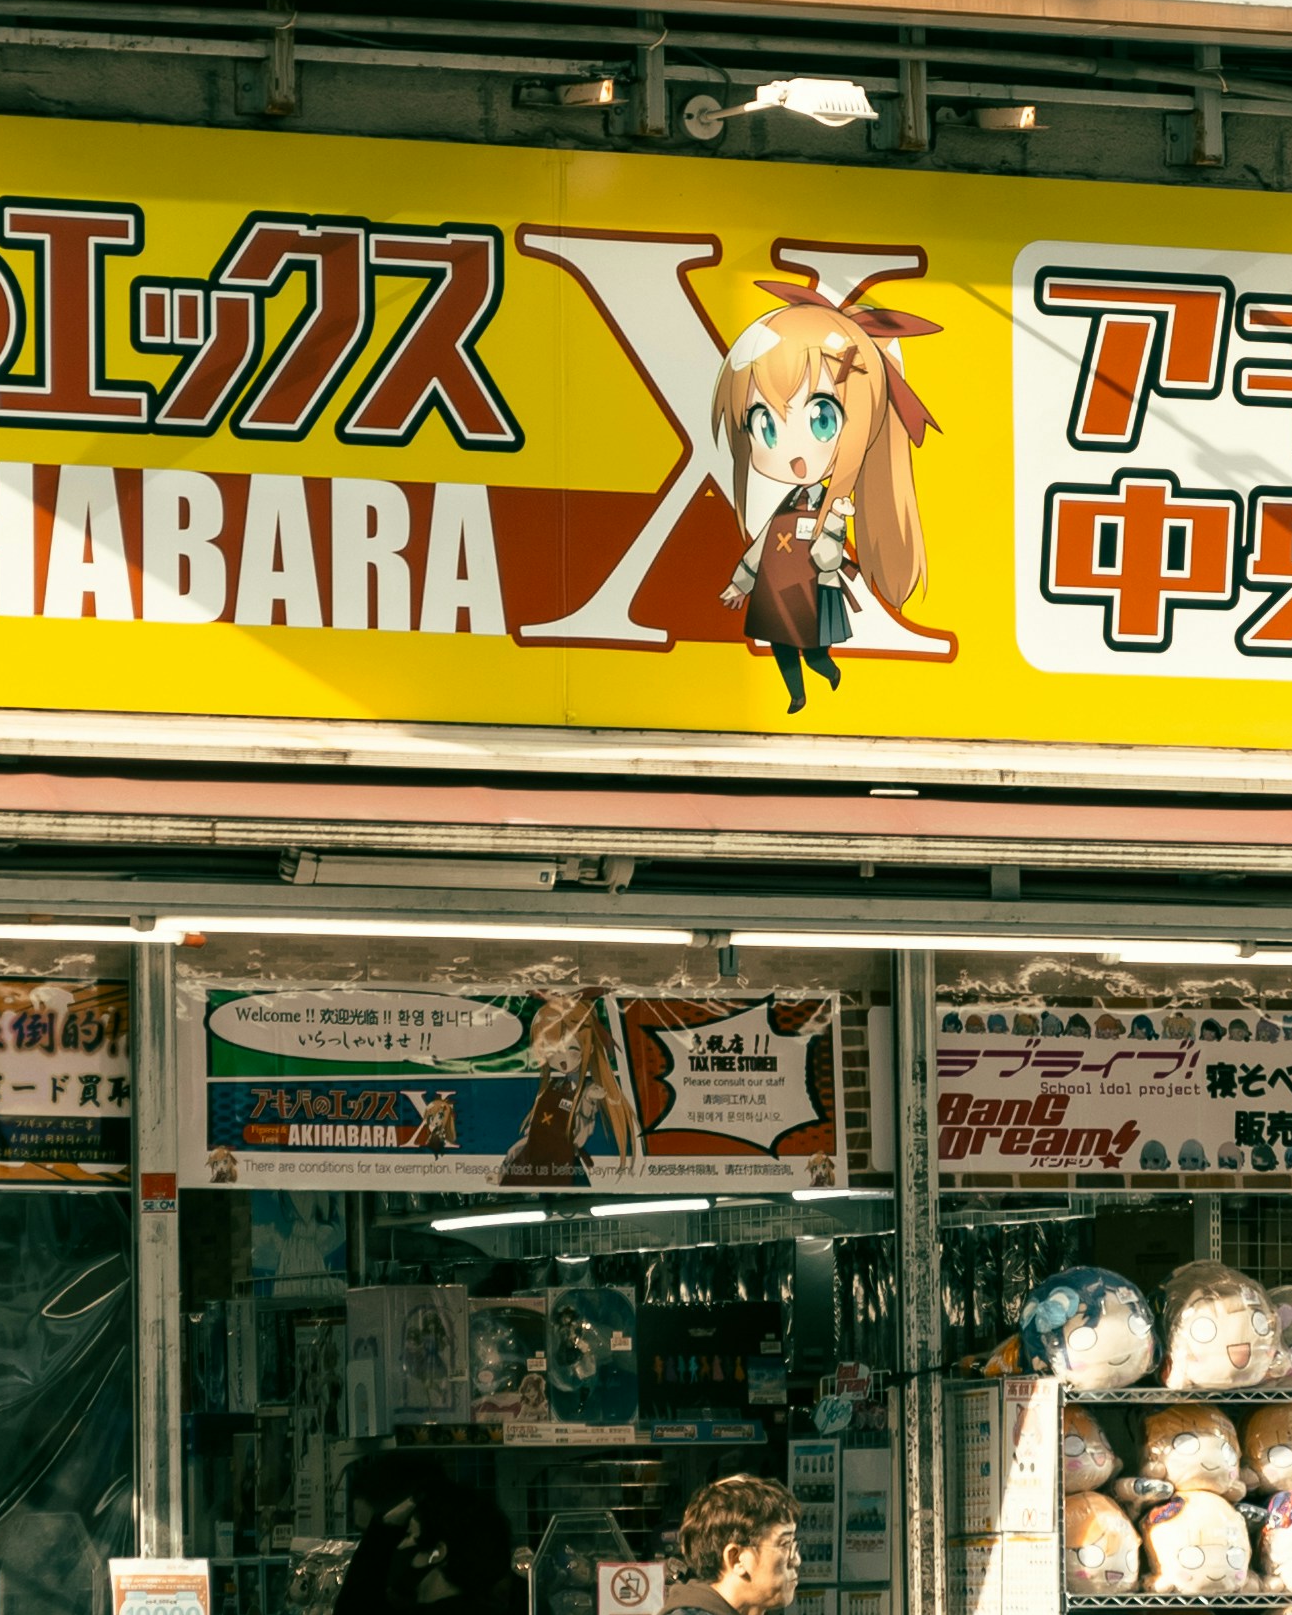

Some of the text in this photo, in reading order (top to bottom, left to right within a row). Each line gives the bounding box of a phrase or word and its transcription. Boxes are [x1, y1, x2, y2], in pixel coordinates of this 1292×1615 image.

[515, 222, 959, 662] X
[235, 1006, 301, 1023] Welcome
[320, 1008, 379, 1026] 欢迎光临
[397, 1010, 425, 1027] 환영
[430, 1011, 474, 1028] 합니다
[298, 1032, 412, 1050] いらっしゃいませ
[688, 1056, 709, 1072] TAX
[710, 1056, 736, 1072] FREE
[937, 1039, 1201, 1080] ラブライブ!
[683, 1076, 786, 1087] Please consult our staff
[1040, 1082, 1201, 1097] School idol project
[249, 1088, 399, 1121] アキバのエックス
[287, 1123, 399, 1148] AKIHABARA
[243, 1159, 275, 1175] There
[278, 1162, 295, 1175] are
[298, 1160, 353, 1176] conditions
[357, 1159, 372, 1175] for
[375, 1162, 392, 1176] tax
[394, 1162, 451, 1179] exemption.
[455, 1161, 491, 1177] Please
[536, 1165, 549, 1177] us
[551, 1163, 585, 1177] before
[1030, 1157, 1094, 1169] バンドリ
[142, 1199, 176, 1211] SEOM
